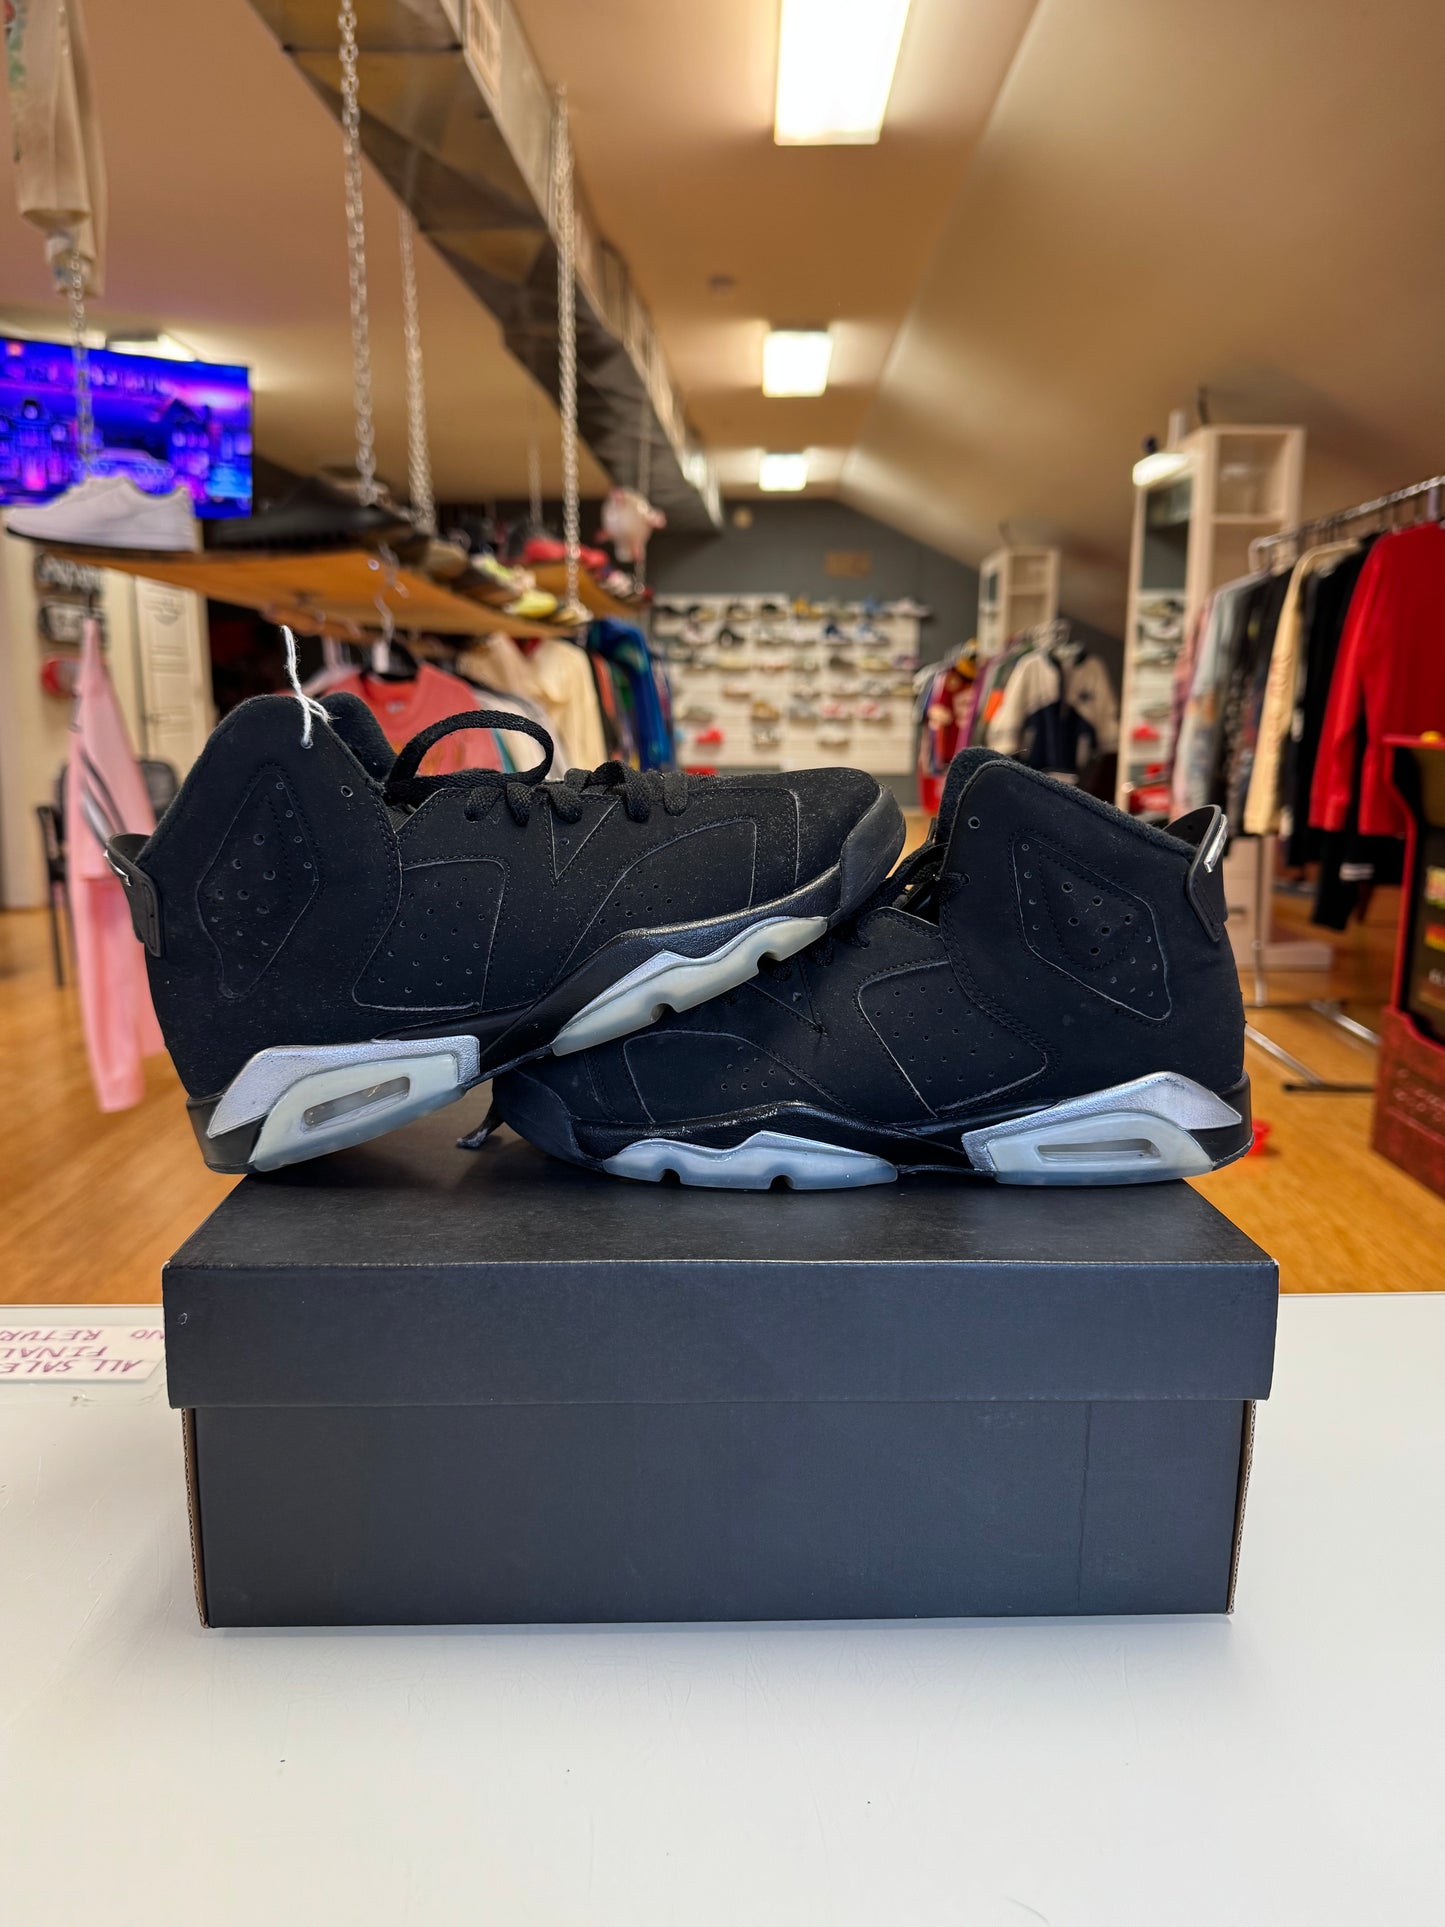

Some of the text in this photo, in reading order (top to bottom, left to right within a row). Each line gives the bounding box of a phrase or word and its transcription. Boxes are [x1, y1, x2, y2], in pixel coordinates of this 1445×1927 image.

[0, 1328, 164, 1342] NO RETUR
[0, 1345, 108, 1359] FINAL
[0, 1358, 144, 1375] ALL SALE
